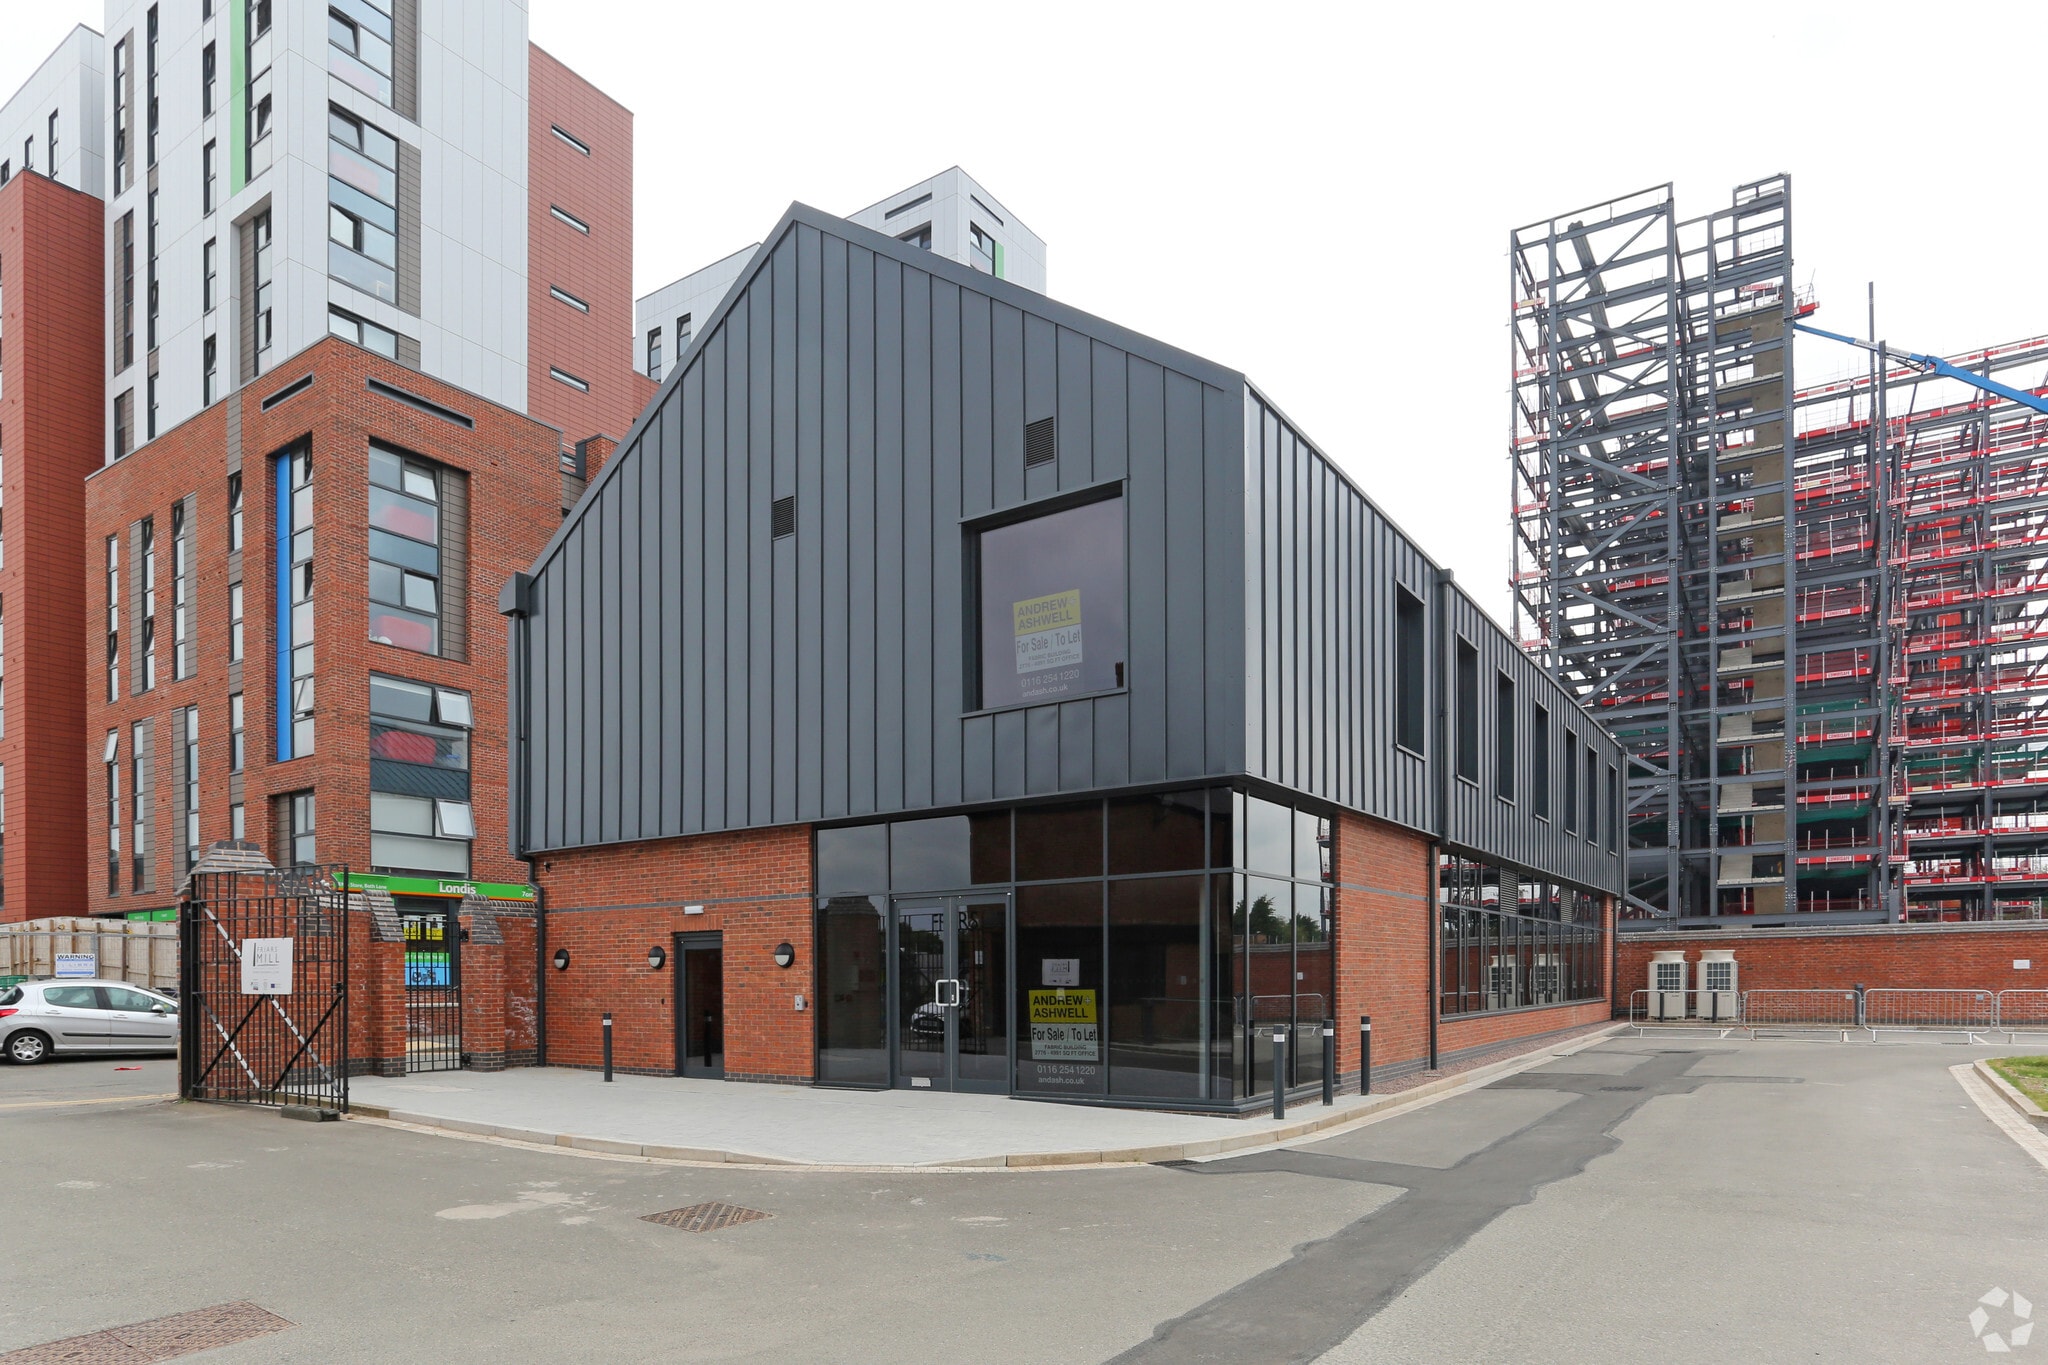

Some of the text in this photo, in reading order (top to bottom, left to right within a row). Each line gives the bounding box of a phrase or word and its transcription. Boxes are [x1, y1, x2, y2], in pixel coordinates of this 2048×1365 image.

[1017, 598, 1068, 617] ANDREW
[1018, 610, 1072, 630] ASHWELL
[1016, 640, 1029, 654] For
[1031, 635, 1048, 651] Sale
[1055, 632, 1066, 646] To
[1068, 629, 1081, 644] Let
[1021, 669, 1079, 687] 0116 254 1220
[1022, 683, 1068, 698] andash.co.uk
[439, 881, 476, 894] Londis
[257, 953, 280, 963] MILL
[1033, 995, 1083, 1006] ANDREW
[1033, 1008, 1088, 1018] ASHWELL
[1032, 1028, 1045, 1041] For
[1047, 1028, 1064, 1041] Sale
[1071, 1028, 1081, 1041] To
[1083, 1029, 1097, 1042] Let
[1037, 1065, 1096, 1075] 0116 254 1220
[1038, 1076, 1085, 1085] andash.co.uk
